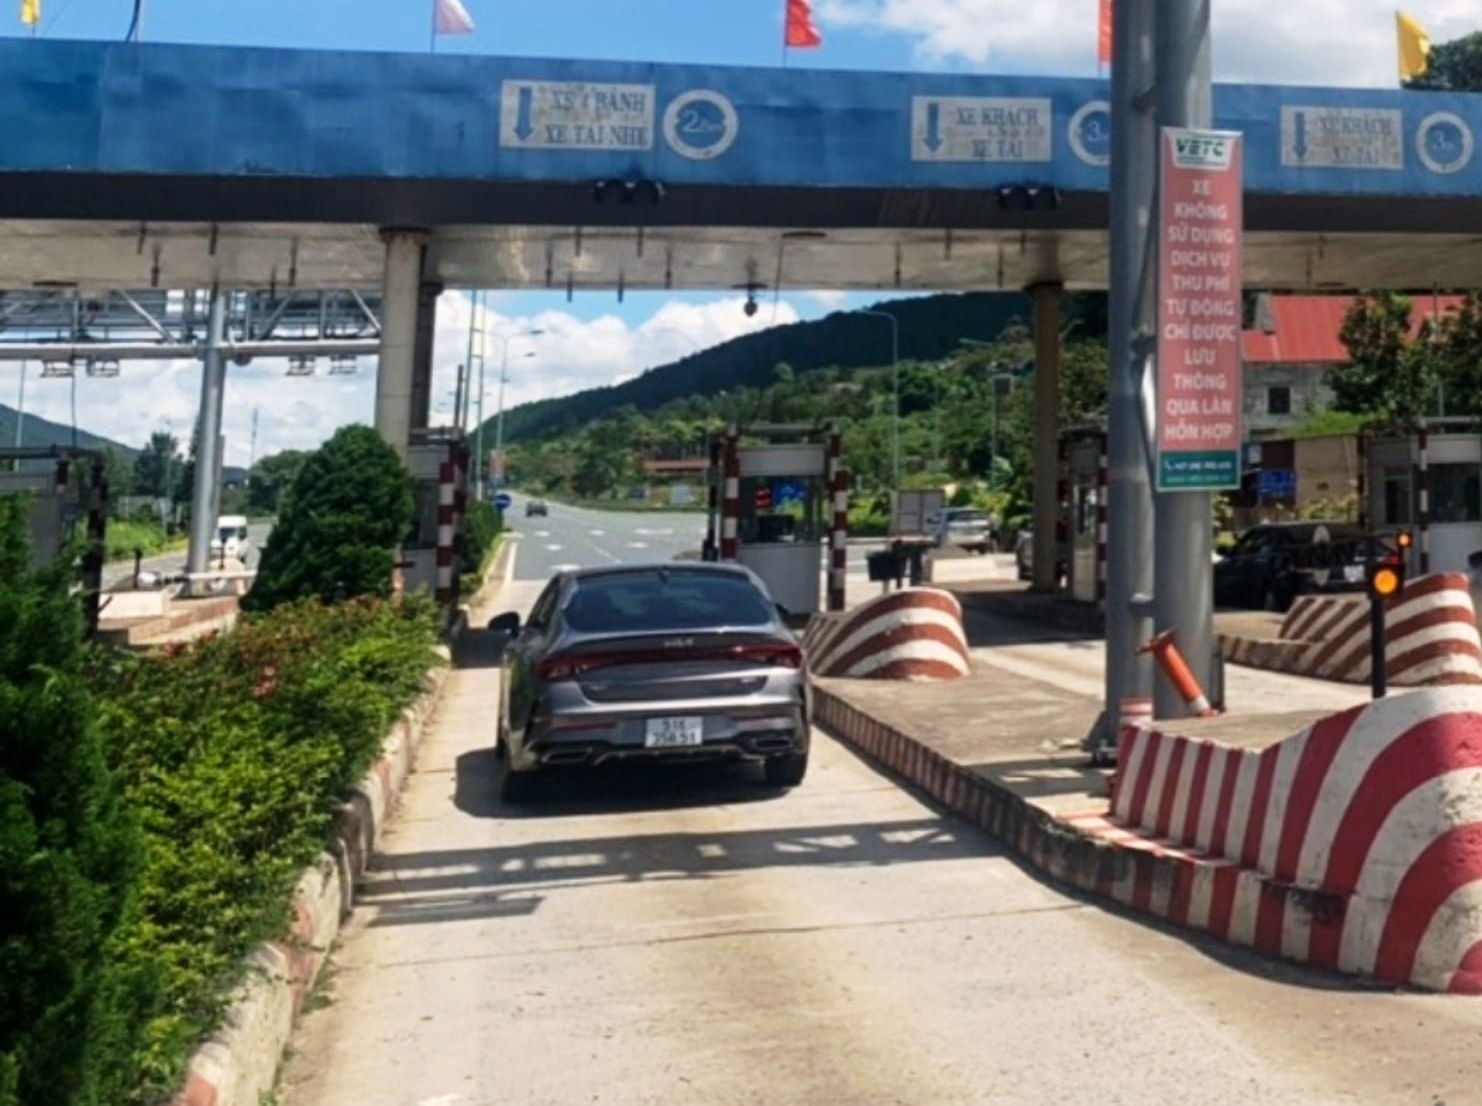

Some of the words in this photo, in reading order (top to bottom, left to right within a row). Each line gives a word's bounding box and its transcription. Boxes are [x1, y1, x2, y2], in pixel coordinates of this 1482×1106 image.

[981, 104, 1039, 126] KHÁCH
[1176, 137, 1225, 157] VETC
[1174, 200, 1228, 220] KHÔNG
[1191, 228, 1234, 248] DỤNG
[1171, 251, 1207, 270] DỊCH
[1172, 275, 1201, 291] THU
[1205, 273, 1230, 291] PHÍ
[1165, 298, 1187, 319] TỰ
[1184, 347, 1216, 365] LƯU
[1172, 371, 1227, 391] THÔNG
[1165, 398, 1200, 417] QUA
[1202, 396, 1232, 415] LÀN
